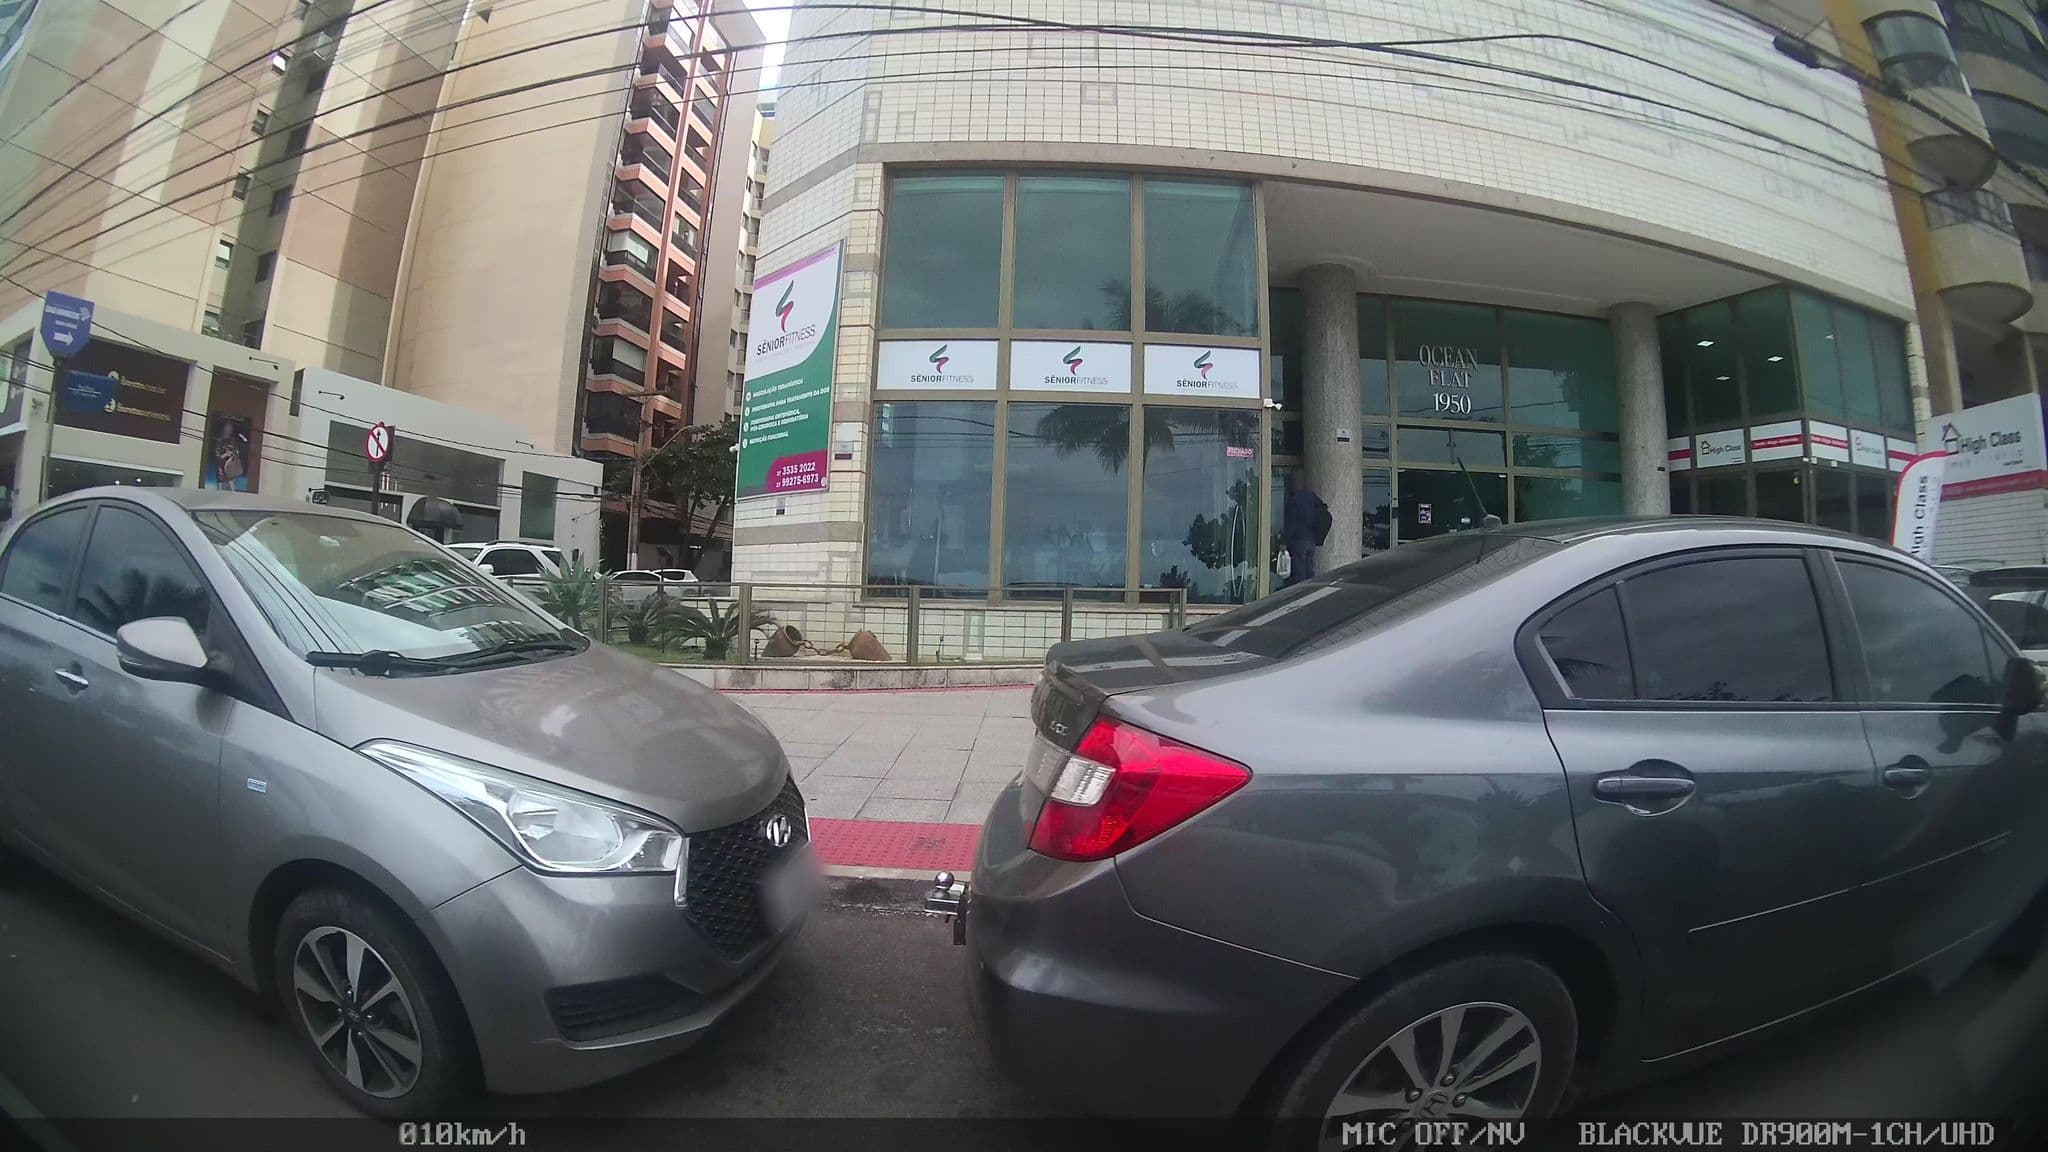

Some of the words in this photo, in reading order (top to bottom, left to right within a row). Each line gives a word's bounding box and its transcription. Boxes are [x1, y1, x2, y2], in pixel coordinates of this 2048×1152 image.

[1419, 344, 1478, 369] OCEAN
[1429, 370, 1472, 388] FLAT
[1433, 392, 1472, 414] 1950
[1710, 446, 1724, 455] High
[1725, 444, 1741, 453] Class
[1960, 434, 1987, 454] High
[1990, 430, 2021, 447] Class
[782, 464, 798, 476] 3535
[799, 461, 816, 473] 2022
[1913, 475, 1928, 520] Class
